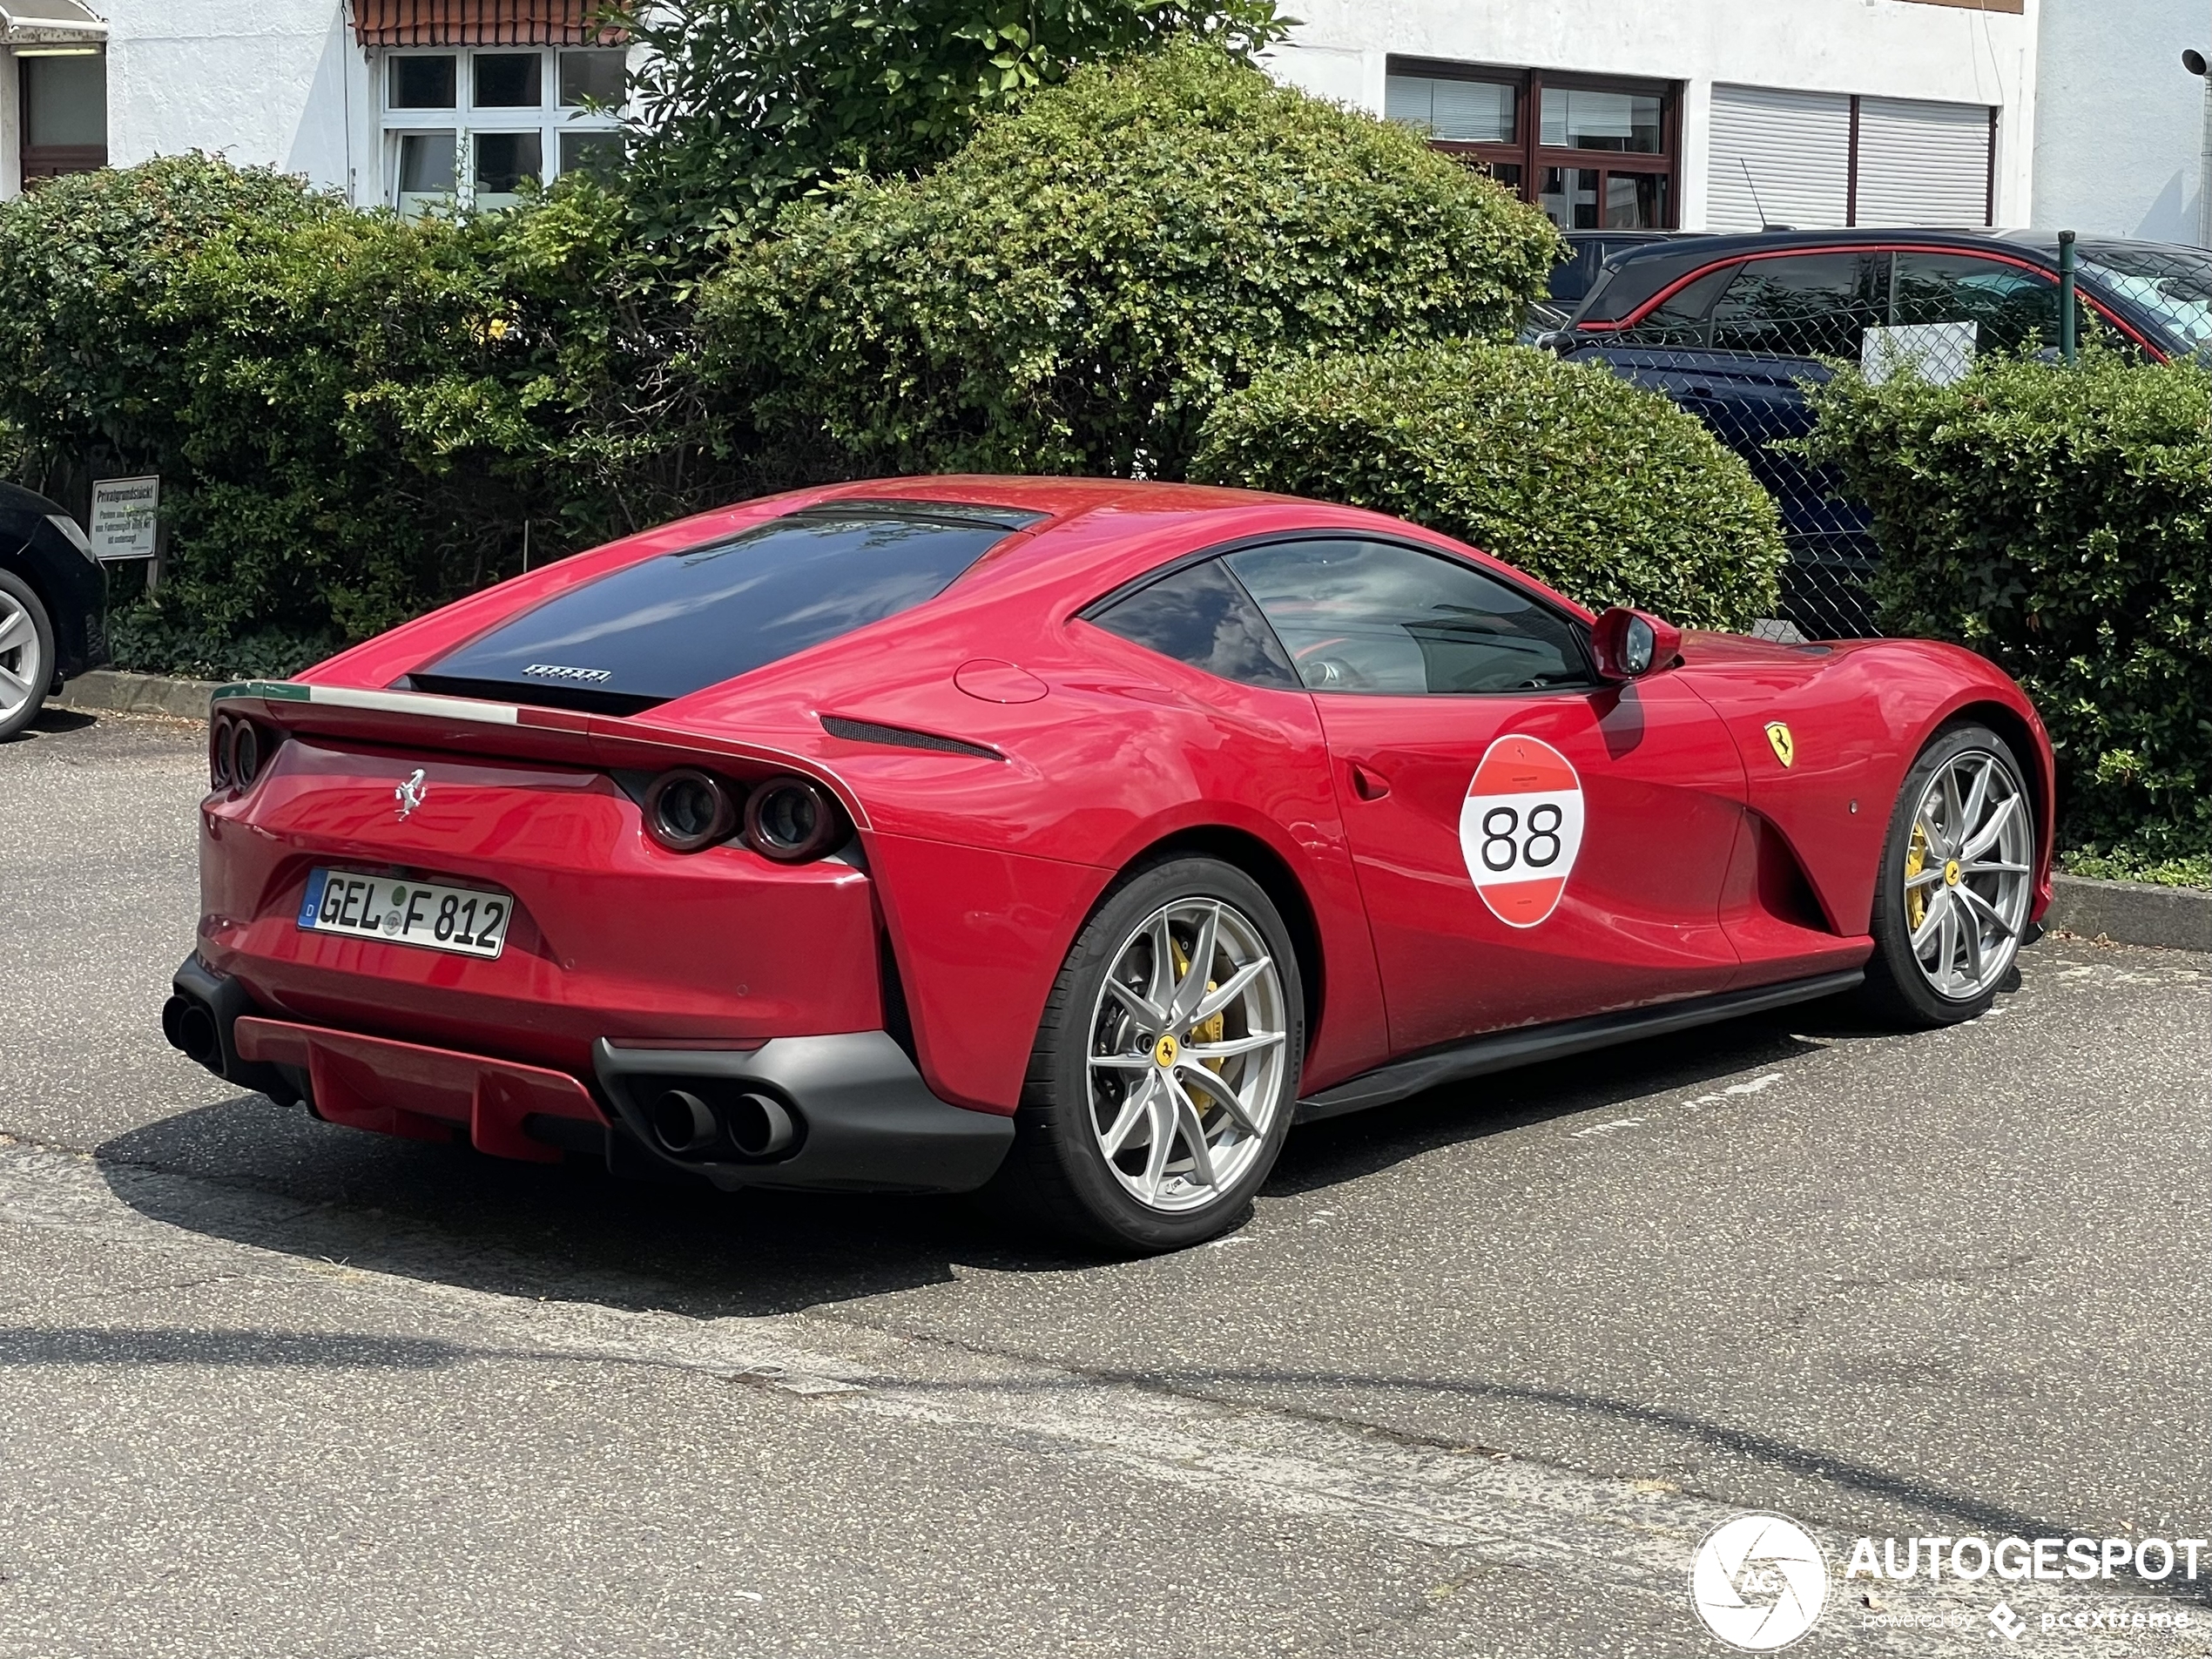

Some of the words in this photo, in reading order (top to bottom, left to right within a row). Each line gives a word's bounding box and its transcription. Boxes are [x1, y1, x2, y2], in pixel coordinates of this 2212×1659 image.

[1481, 804, 1562, 872] 88
[306, 904, 314, 917] D
[320, 878, 381, 930] GEL
[402, 890, 432, 934] F
[435, 894, 504, 948] 812
